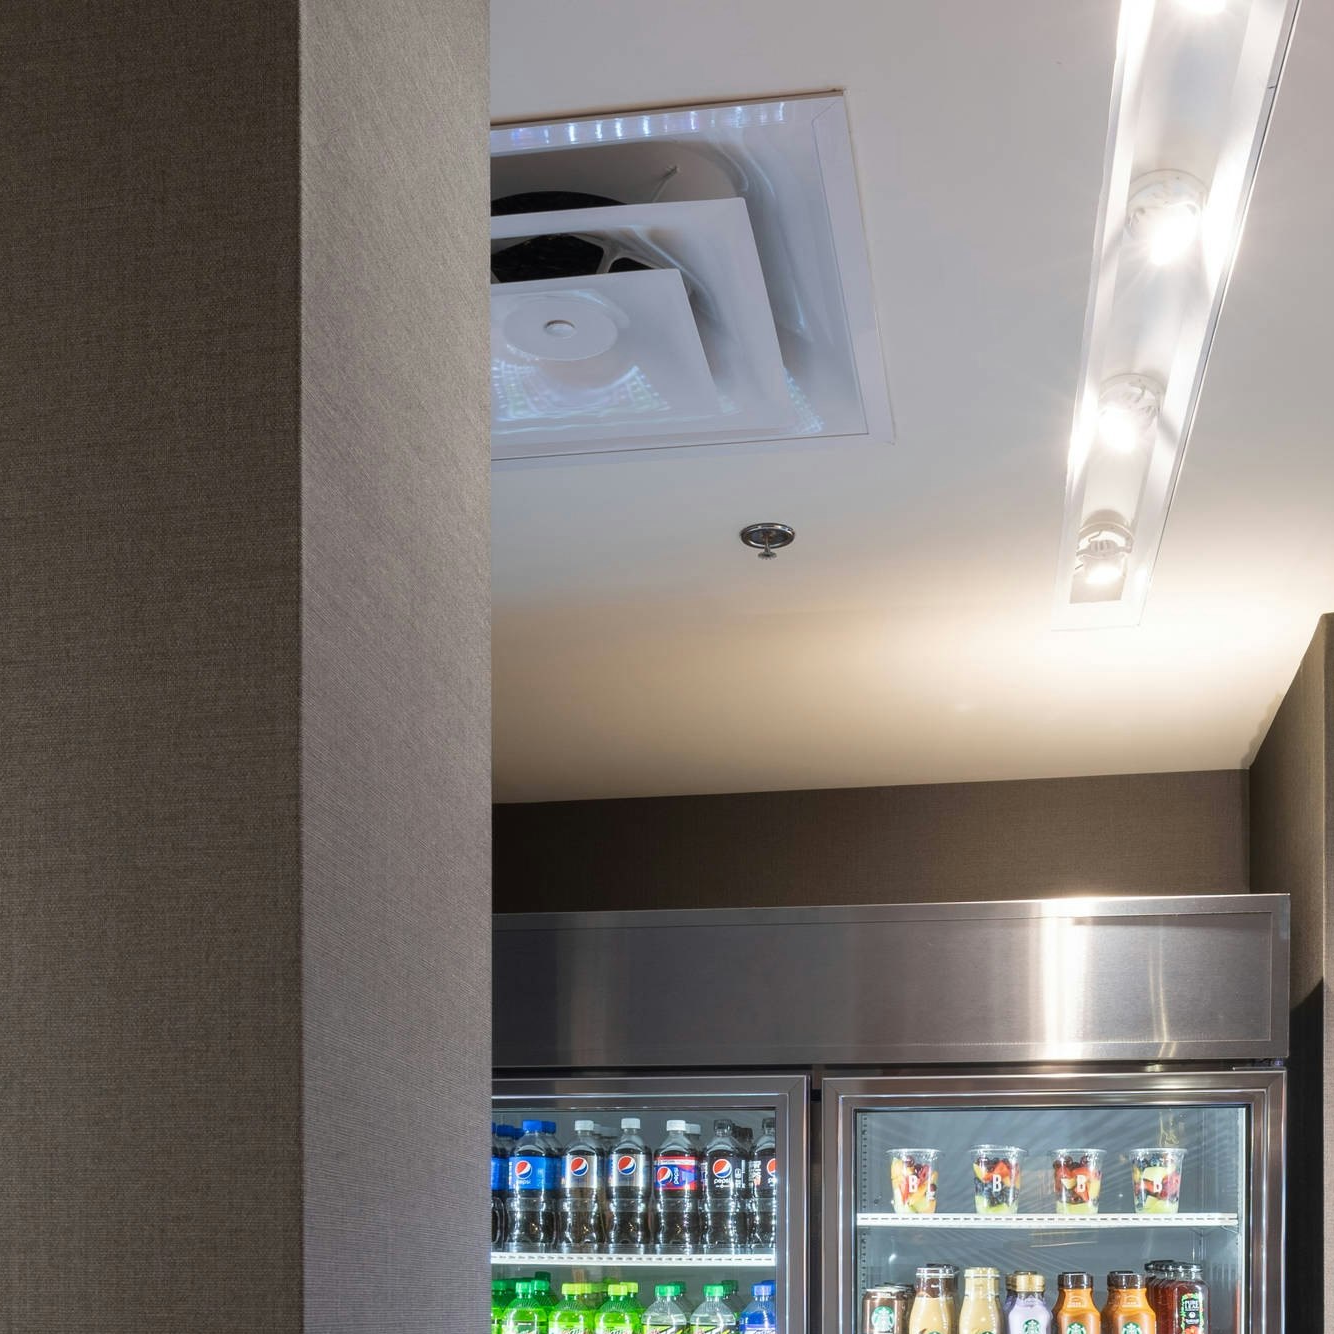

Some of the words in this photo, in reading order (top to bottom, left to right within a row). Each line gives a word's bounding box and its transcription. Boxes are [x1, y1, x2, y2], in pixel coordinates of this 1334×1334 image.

[908, 1174, 918, 1193] B
[992, 1174, 1002, 1193] B
[1076, 1174, 1086, 1193] B
